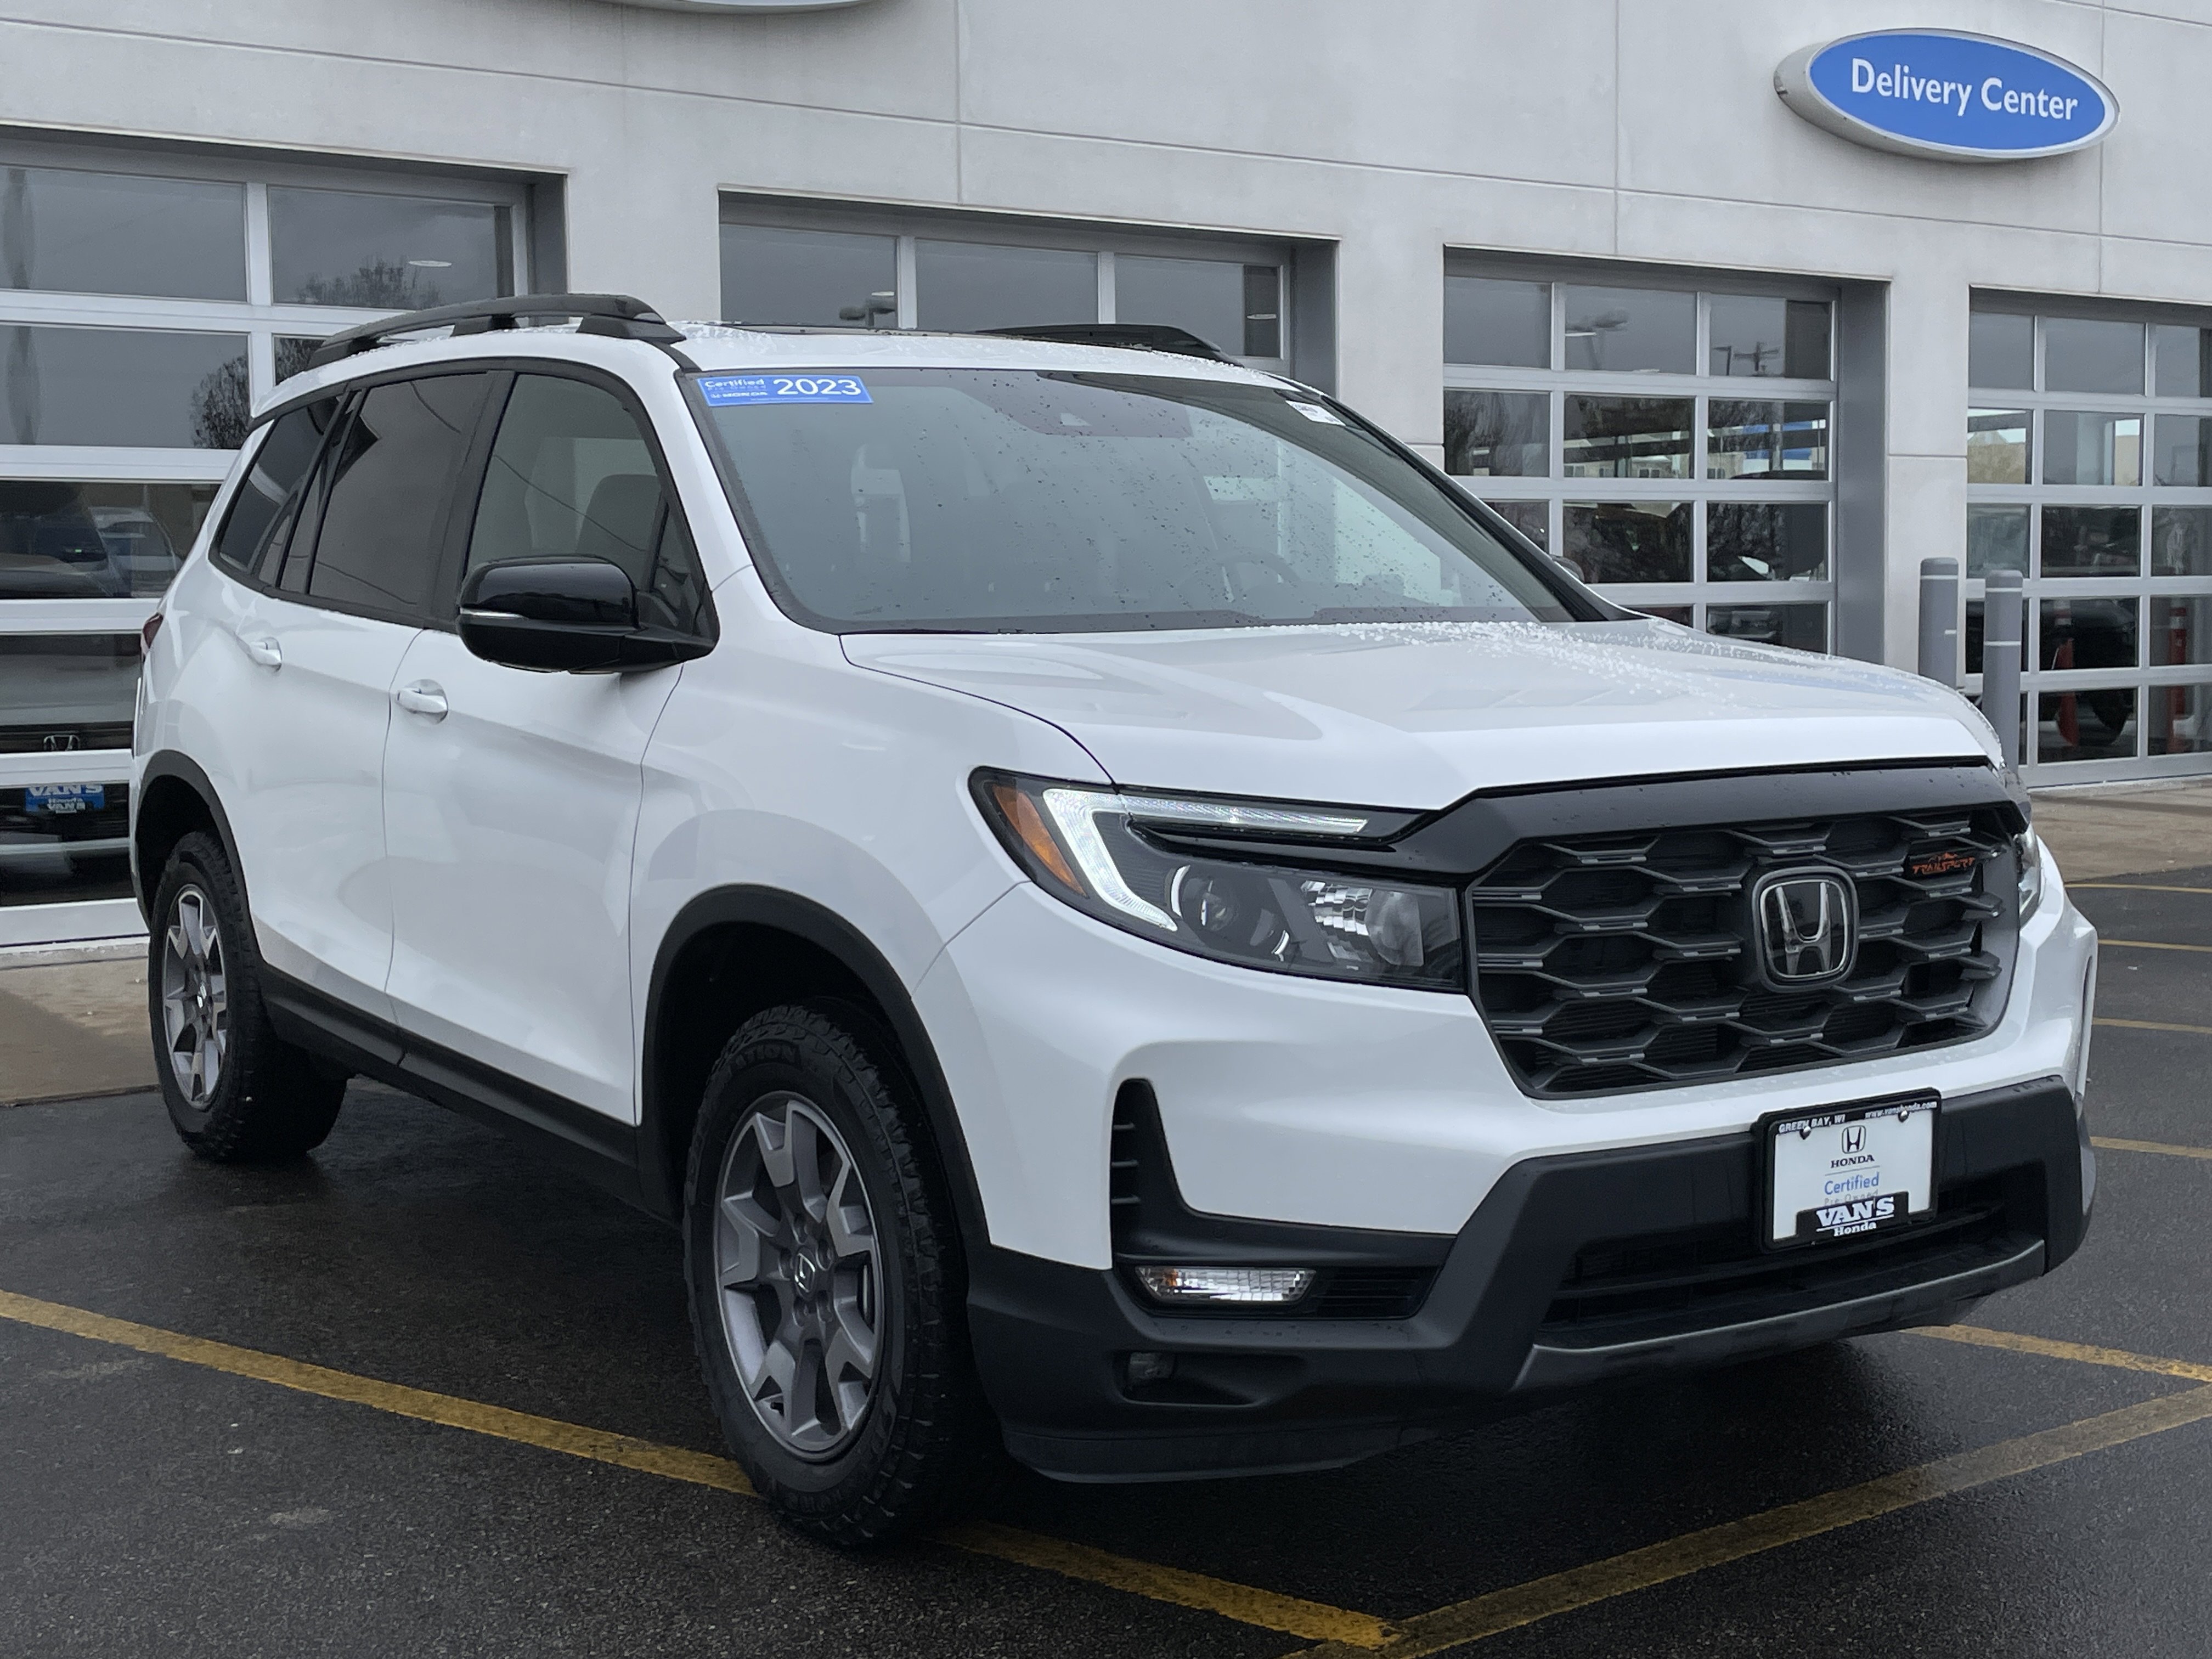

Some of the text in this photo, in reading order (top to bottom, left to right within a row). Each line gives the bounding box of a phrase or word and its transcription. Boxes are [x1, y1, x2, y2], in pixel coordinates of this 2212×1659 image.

[1852, 57, 2078, 120] Delivery Center
[704, 379, 764, 387] Certified
[773, 378, 861, 396] 2023
[1778, 1119, 1810, 1134] GREEN
[1834, 1114, 1846, 1124] WI
[1830, 1154, 1875, 1169] HONDA
[1824, 1171, 1880, 1195] Certified
[1833, 1221, 1877, 1237] Honda
